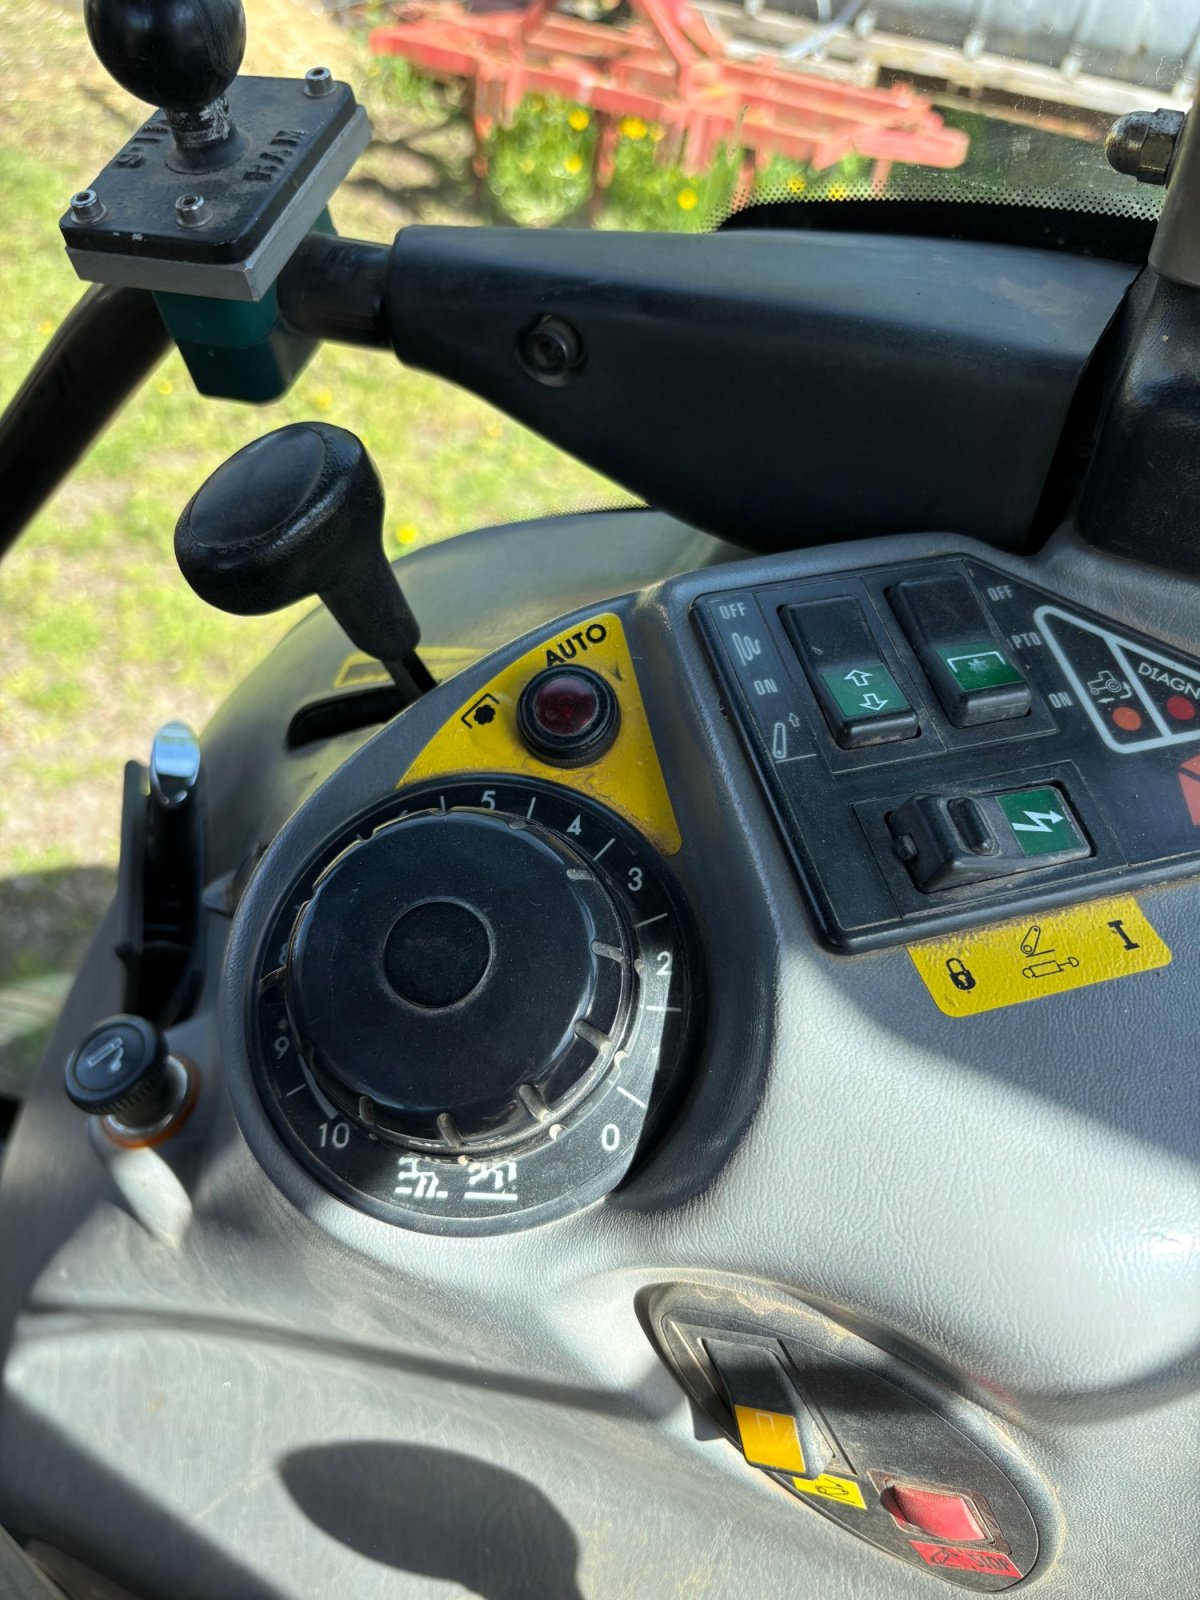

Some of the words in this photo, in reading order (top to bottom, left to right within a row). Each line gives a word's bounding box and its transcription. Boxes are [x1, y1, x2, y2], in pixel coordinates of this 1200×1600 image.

[243, 130, 305, 180] RAM
[986, 585, 1013, 602] OFF
[719, 602, 746, 620] OFF
[545, 623, 607, 667] AUTO
[1011, 631, 1042, 649] PTO
[753, 678, 779, 696] ON
[1137, 661, 1200, 700] DIAGN
[1048, 691, 1074, 709] ON
[480, 790, 496, 809] 5
[566, 814, 583, 836] 4
[627, 868, 644, 891] 3
[655, 950, 672, 976] 2
[274, 1035, 290, 1060] 9
[318, 1122, 350, 1149] 10
[601, 1123, 620, 1151] 0
